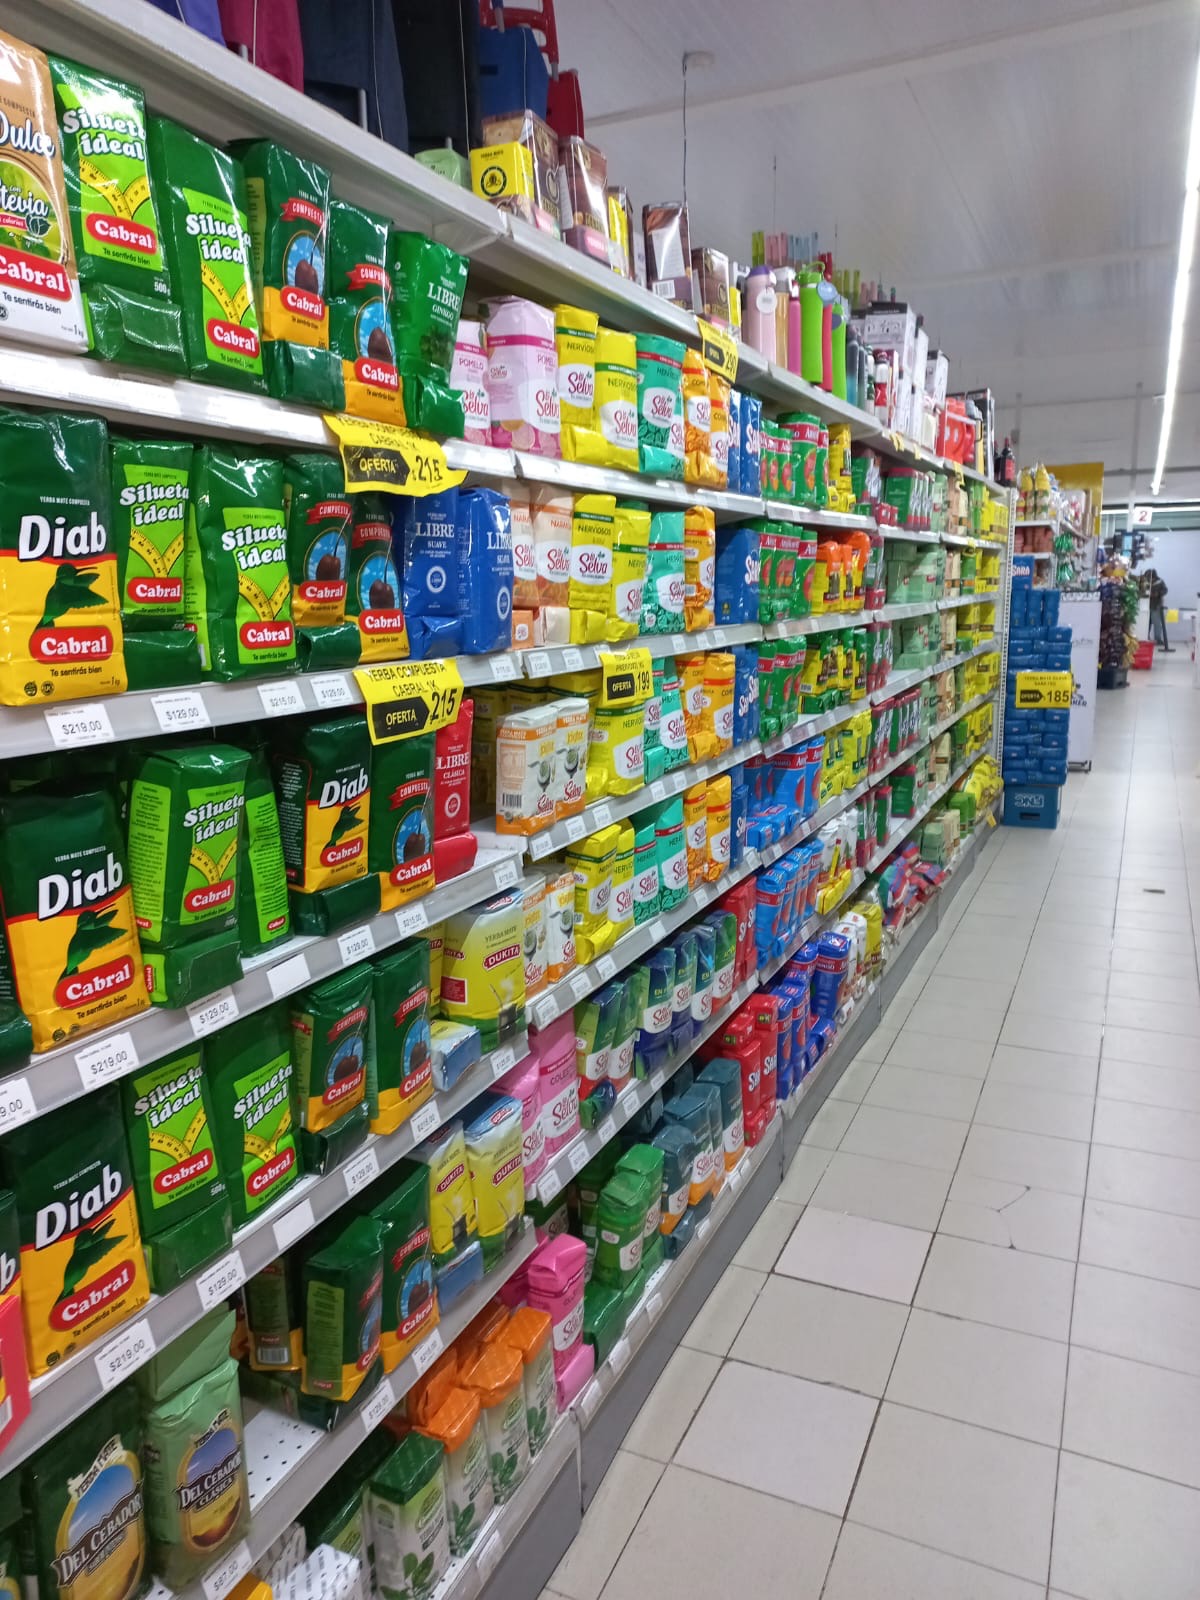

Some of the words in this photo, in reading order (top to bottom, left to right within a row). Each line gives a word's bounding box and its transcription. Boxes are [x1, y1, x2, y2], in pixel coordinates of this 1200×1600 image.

[80, 131, 146, 161] ideal
[0, 182, 48, 216] tevia
[95, 220, 153, 249] Cabral
[3, 291, 12, 302] Te
[14, 295, 44, 311] sentirás
[45, 302, 62, 315] bien
[287, 293, 323, 317] Cabral
[427, 281, 460, 312] LIBRE
[213, 325, 256, 353] Cabral
[459, 356, 483, 371] POMELO
[361, 365, 399, 388] Cabral
[568, 371, 593, 396] Selva
[360, 458, 396, 474] OFERTA
[120, 483, 190, 506] Silueta
[134, 503, 184, 526] ideal
[1138, 510, 1149, 522] 2
[18, 511, 107, 561] Diab
[415, 522, 455, 538] LIBRE
[238, 544, 287, 570] ideal
[428, 540, 447, 549] SUAVE
[579, 552, 608, 577] Selva
[1012, 565, 1031, 577] SARA
[136, 583, 181, 598] Cabral
[306, 585, 343, 598] Cabral
[365, 616, 401, 630] Cabral
[41, 635, 108, 656] Cabral
[247, 628, 290, 644] Cabral
[50, 668, 58, 677] Te
[60, 667, 86, 675] sentirás
[88, 665, 102, 674] bien
[369, 667, 397, 681] YERBA
[612, 681, 632, 693] OFERTA
[62, 720, 103, 736] $219.00
[386, 709, 417, 726] OFERTA
[434, 751, 469, 770] LIBRE
[318, 767, 369, 810] Diab
[183, 794, 245, 829] Silueta
[194, 811, 239, 844] ideal
[326, 844, 361, 864] Cabral
[397, 858, 432, 882] Cabral
[37, 852, 124, 921] Diab
[191, 883, 231, 908] Cabral
[488, 946, 520, 968] DUKITA
[66, 963, 131, 1001] Cabral
[91, 1050, 128, 1075] $219.00
[134, 1064, 203, 1117] Silueta
[233, 1063, 293, 1120] Silueta
[328, 1074, 361, 1100] Cabral
[0, 1098, 23, 1118] 9.00
[150, 1082, 200, 1129] ideal
[245, 1082, 288, 1130] ideal
[161, 1155, 209, 1188] Cabral
[252, 1153, 292, 1191] Cabral
[35, 1164, 123, 1250] Diab
[61, 1267, 130, 1323] Cabral
[402, 1298, 434, 1335] Cabral
[110, 1338, 145, 1373] $219.00
[180, 1483, 203, 1509] DEL
[199, 1476, 233, 1506] CLASICA
[60, 1545, 90, 1584] DEL
